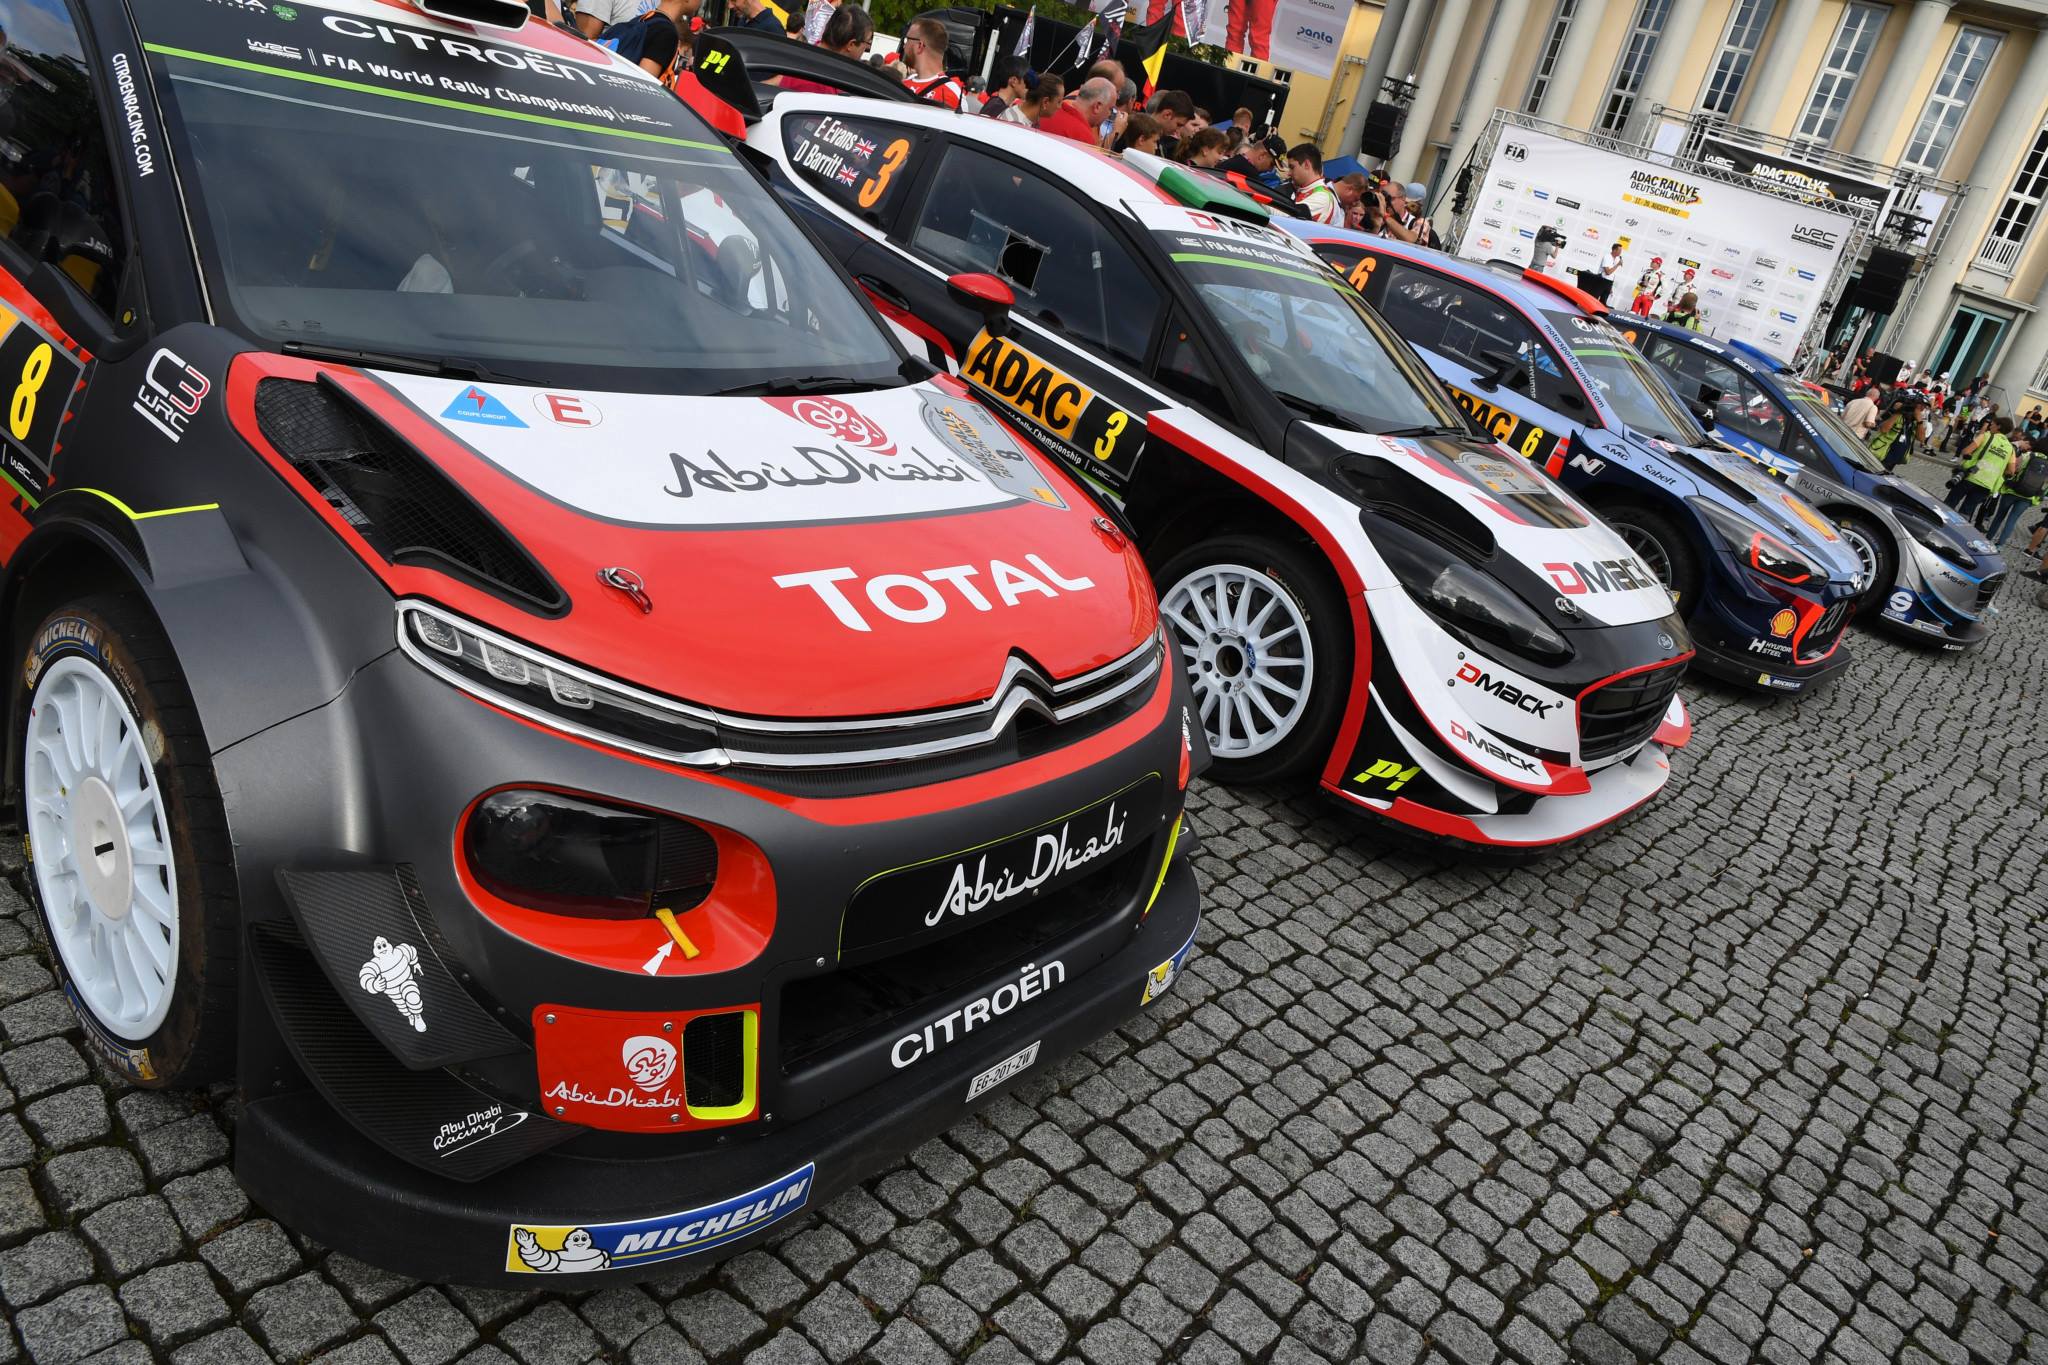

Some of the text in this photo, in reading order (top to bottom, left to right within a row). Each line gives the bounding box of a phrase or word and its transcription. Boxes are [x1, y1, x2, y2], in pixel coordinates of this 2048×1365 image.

[322, 15, 597, 86] CITROËN
[322, 53, 364, 73] FIA
[367, 62, 435, 87] World
[439, 76, 491, 99] Rally
[498, 87, 615, 122] Championship
[112, 53, 154, 177] CITROENRACING.COM
[814, 116, 859, 152] E Evans
[793, 140, 844, 179] D Barritt
[858, 138, 910, 208] 3
[1752, 162, 1785, 181] ADAC
[1785, 171, 1830, 194] RALLYE
[1630, 170, 1700, 199] ADAC RALLYE
[1630, 181, 1686, 203] DEUTSCHLAND
[1794, 224, 1839, 244] WRC
[1349, 256, 1377, 292] 6
[1544, 324, 1606, 409] motorsport.hyundai.com
[10, 342, 53, 441] 8
[138, 384, 190, 433] WRC
[545, 394, 592, 425] E
[968, 337, 1128, 460] ADAC 3
[1449, 388, 1544, 458] DAC 6
[1034, 427, 1082, 466] Championship
[1642, 464, 1677, 486] Sabelt
[1799, 478, 1834, 500] PULSAR
[771, 554, 1096, 633] TOTAL
[1543, 556, 1661, 595] DMACK
[38, 621, 98, 654] MICHELIN
[1761, 648, 1782, 658] STEEL
[1765, 642, 1793, 653] HYUNDAI
[1455, 662, 1558, 720] DMACK
[1450, 719, 1542, 777] DMACK
[891, 959, 1066, 1069] CITROËN
[974, 1050, 1033, 1092] EG-201-ZW
[433, 1116, 503, 1151] Racing
[440, 1104, 503, 1137] Abu Dhabi
[614, 1182, 811, 1256] MICHELIN
